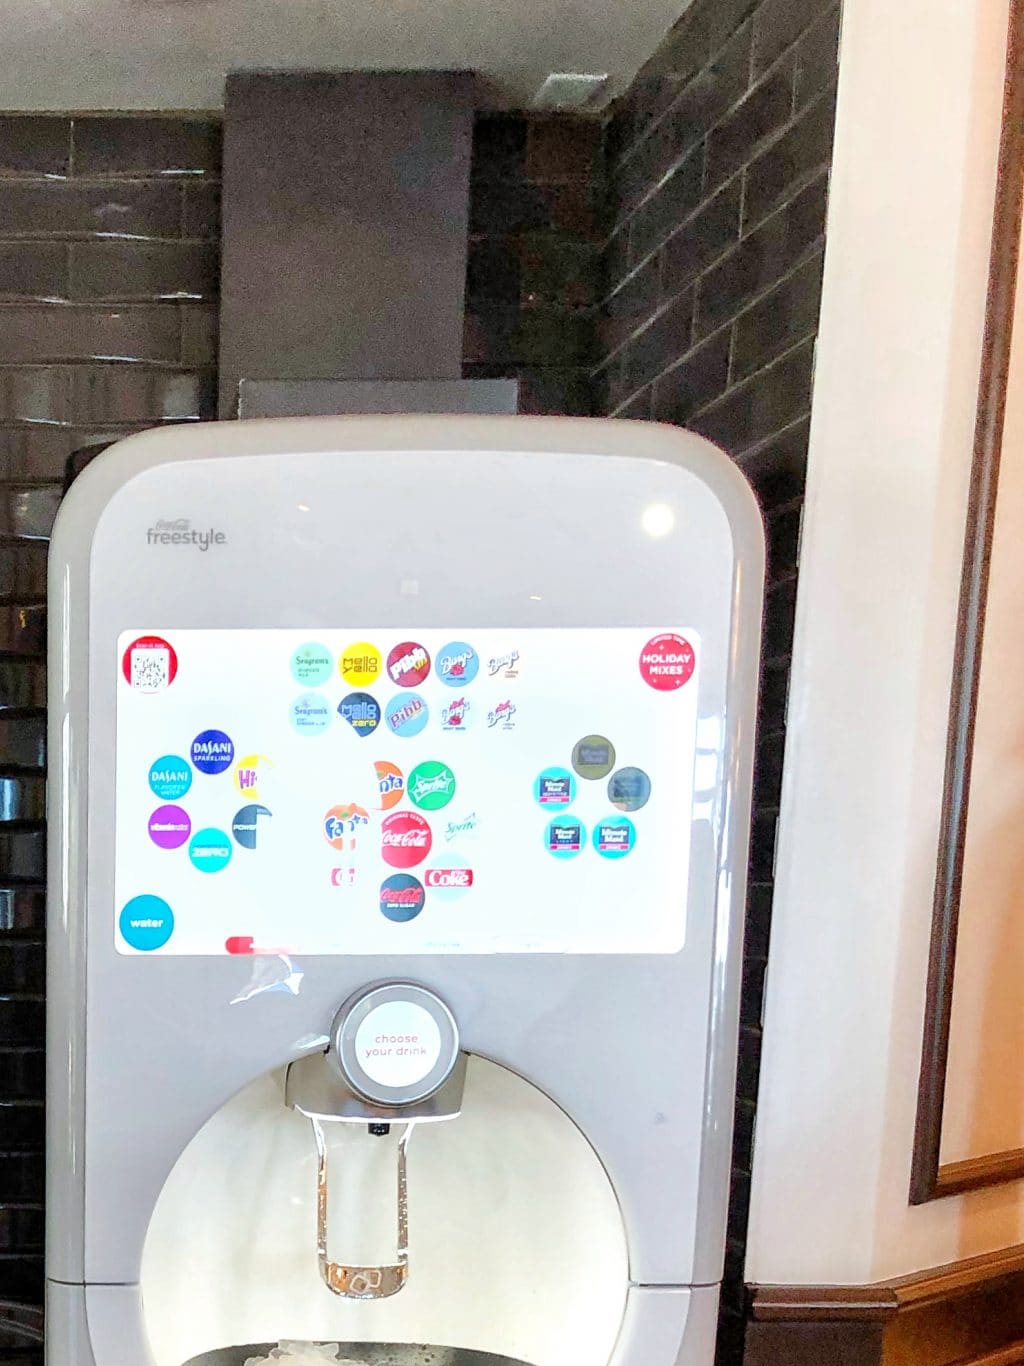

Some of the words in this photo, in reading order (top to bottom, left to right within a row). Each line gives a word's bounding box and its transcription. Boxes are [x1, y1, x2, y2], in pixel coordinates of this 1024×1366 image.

[146, 528, 225, 552] freestyle
[642, 654, 690, 663] HOLIDAY
[649, 666, 683, 675] MIXES
[390, 699, 424, 729] Pibb
[193, 740, 231, 755] DASANI
[151, 769, 188, 783] DASANI
[379, 773, 403, 793] nta
[428, 870, 469, 887] Coke
[130, 918, 163, 928] water
[375, 1034, 419, 1044] choose
[365, 1048, 393, 1058] your
[396, 1046, 427, 1056] drink
